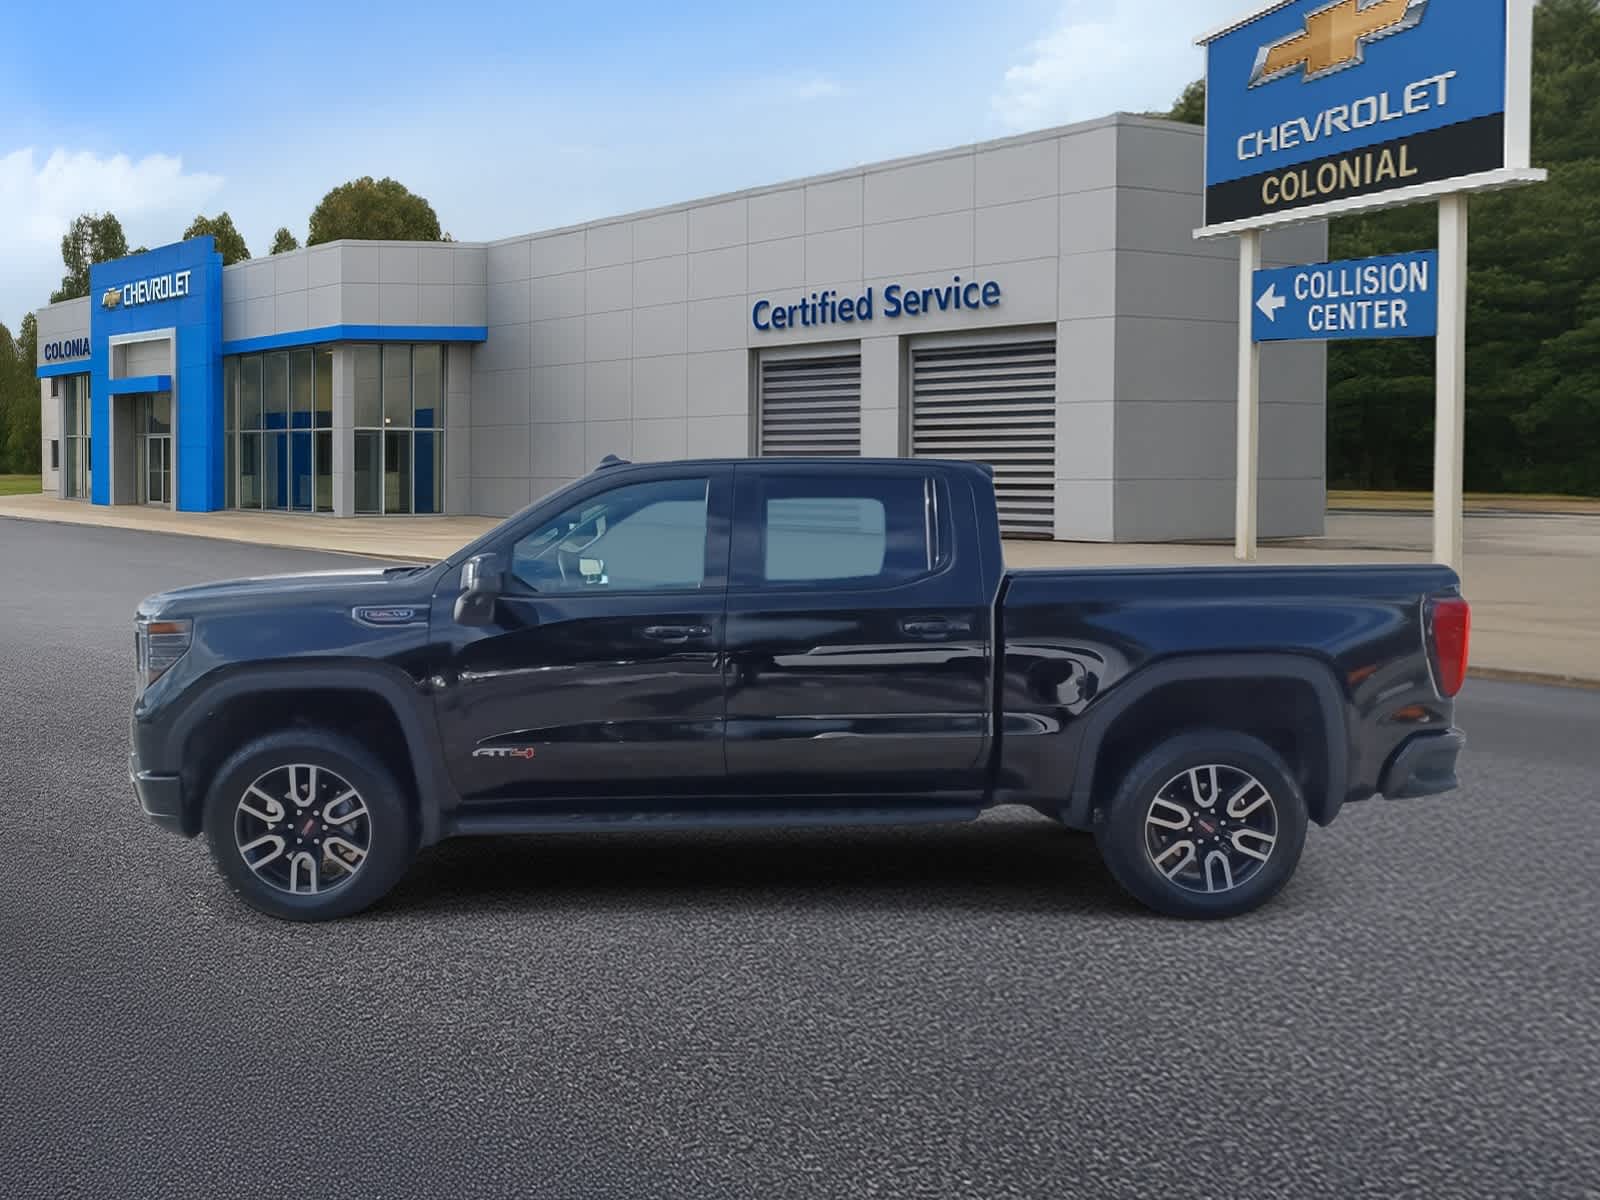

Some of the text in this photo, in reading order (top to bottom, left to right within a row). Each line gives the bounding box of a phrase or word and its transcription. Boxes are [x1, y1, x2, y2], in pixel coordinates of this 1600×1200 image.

[1237, 70, 1456, 160] CHEVROLET
[1262, 144, 1418, 205] COLONIAL
[123, 270, 191, 306] CHEVROLET
[752, 275, 1001, 331] Certified Service
[1294, 261, 1428, 301] COLLISION
[1308, 299, 1408, 331] CENTER
